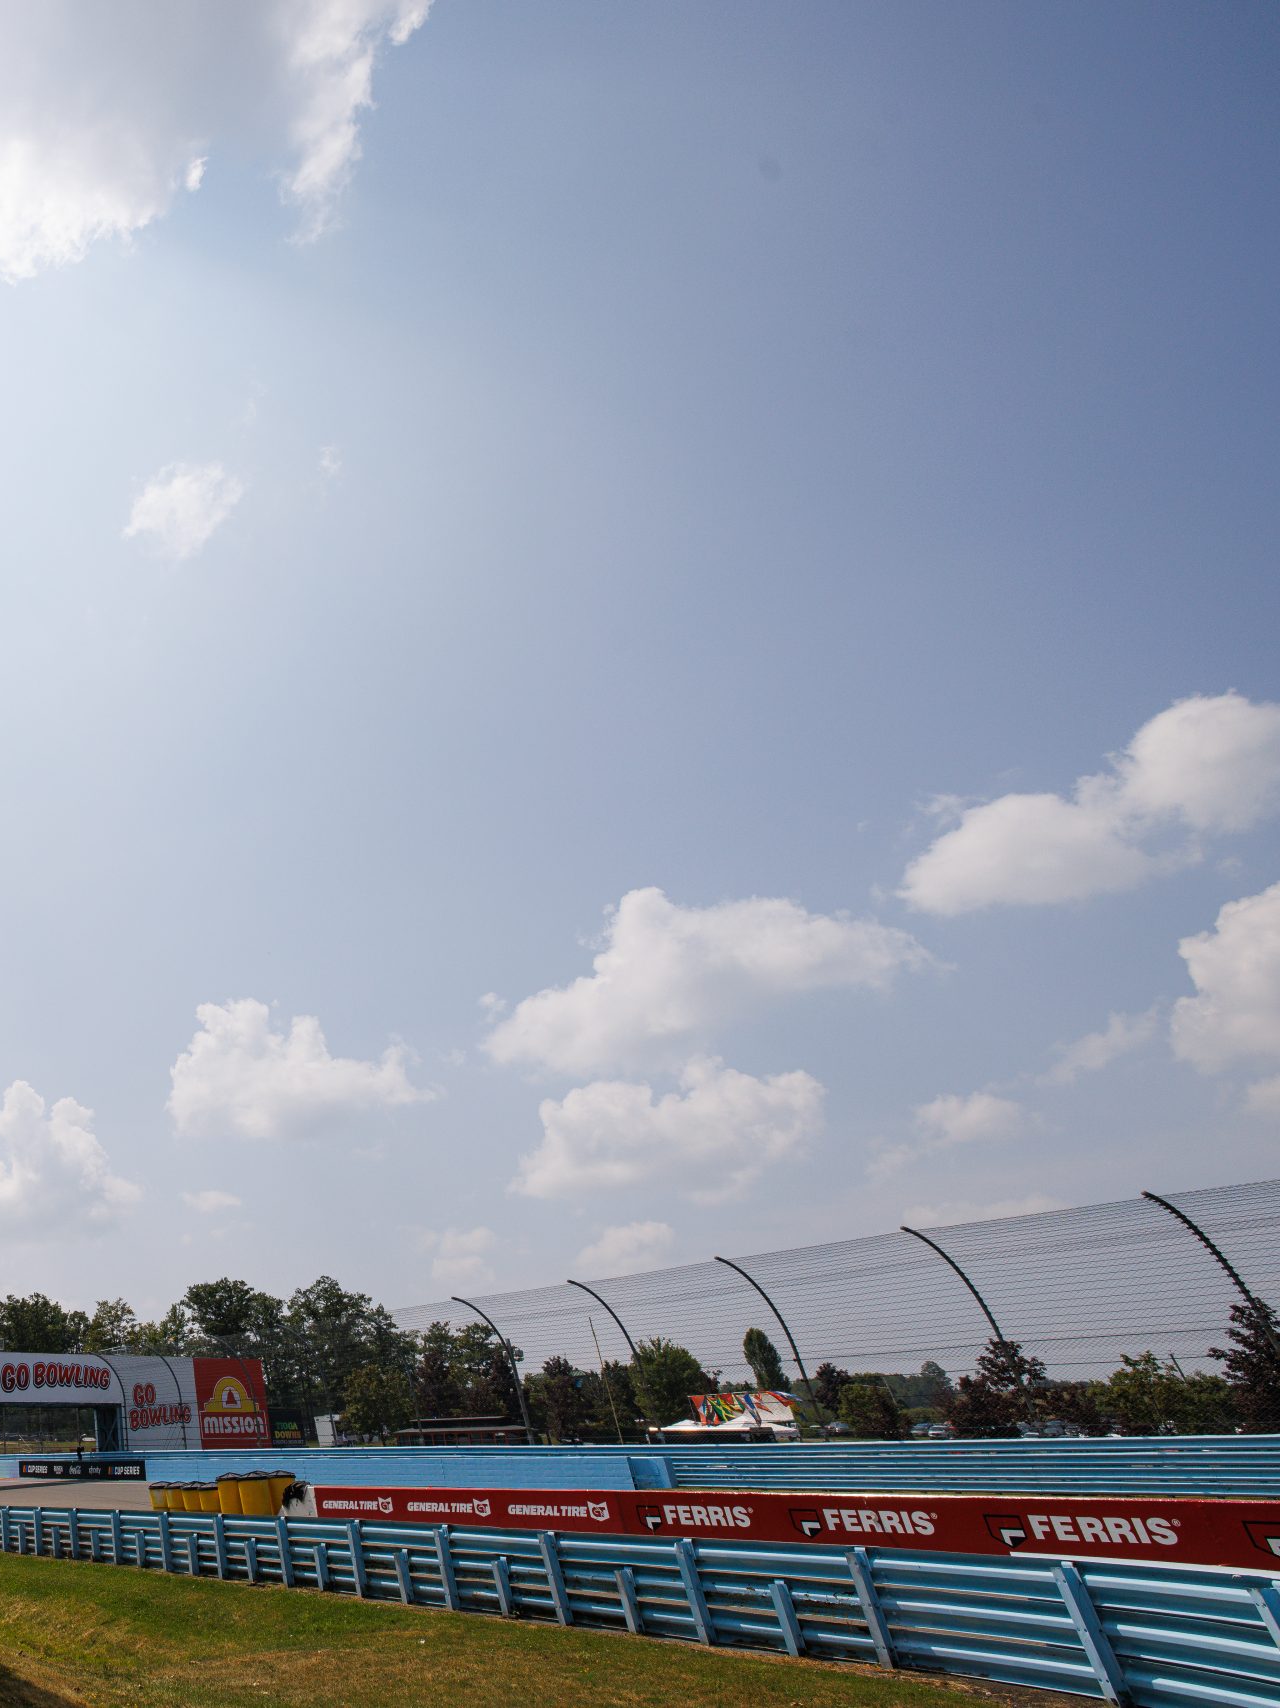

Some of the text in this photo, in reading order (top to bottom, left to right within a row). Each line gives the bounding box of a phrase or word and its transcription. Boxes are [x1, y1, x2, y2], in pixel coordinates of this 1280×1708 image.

[1, 1362, 111, 1392] GO BOWLING
[132, 1383, 156, 1407] GO
[128, 1403, 192, 1431] BOWLING
[114, 1466, 140, 1475] CUP SERIES
[322, 1500, 359, 1510] GENERAL
[358, 1501, 378, 1511] TIRE
[407, 1502, 450, 1512] GENERAL
[450, 1503, 473, 1513] TIRE
[508, 1504, 560, 1516] GENERAL
[560, 1505, 587, 1517] TIRE
